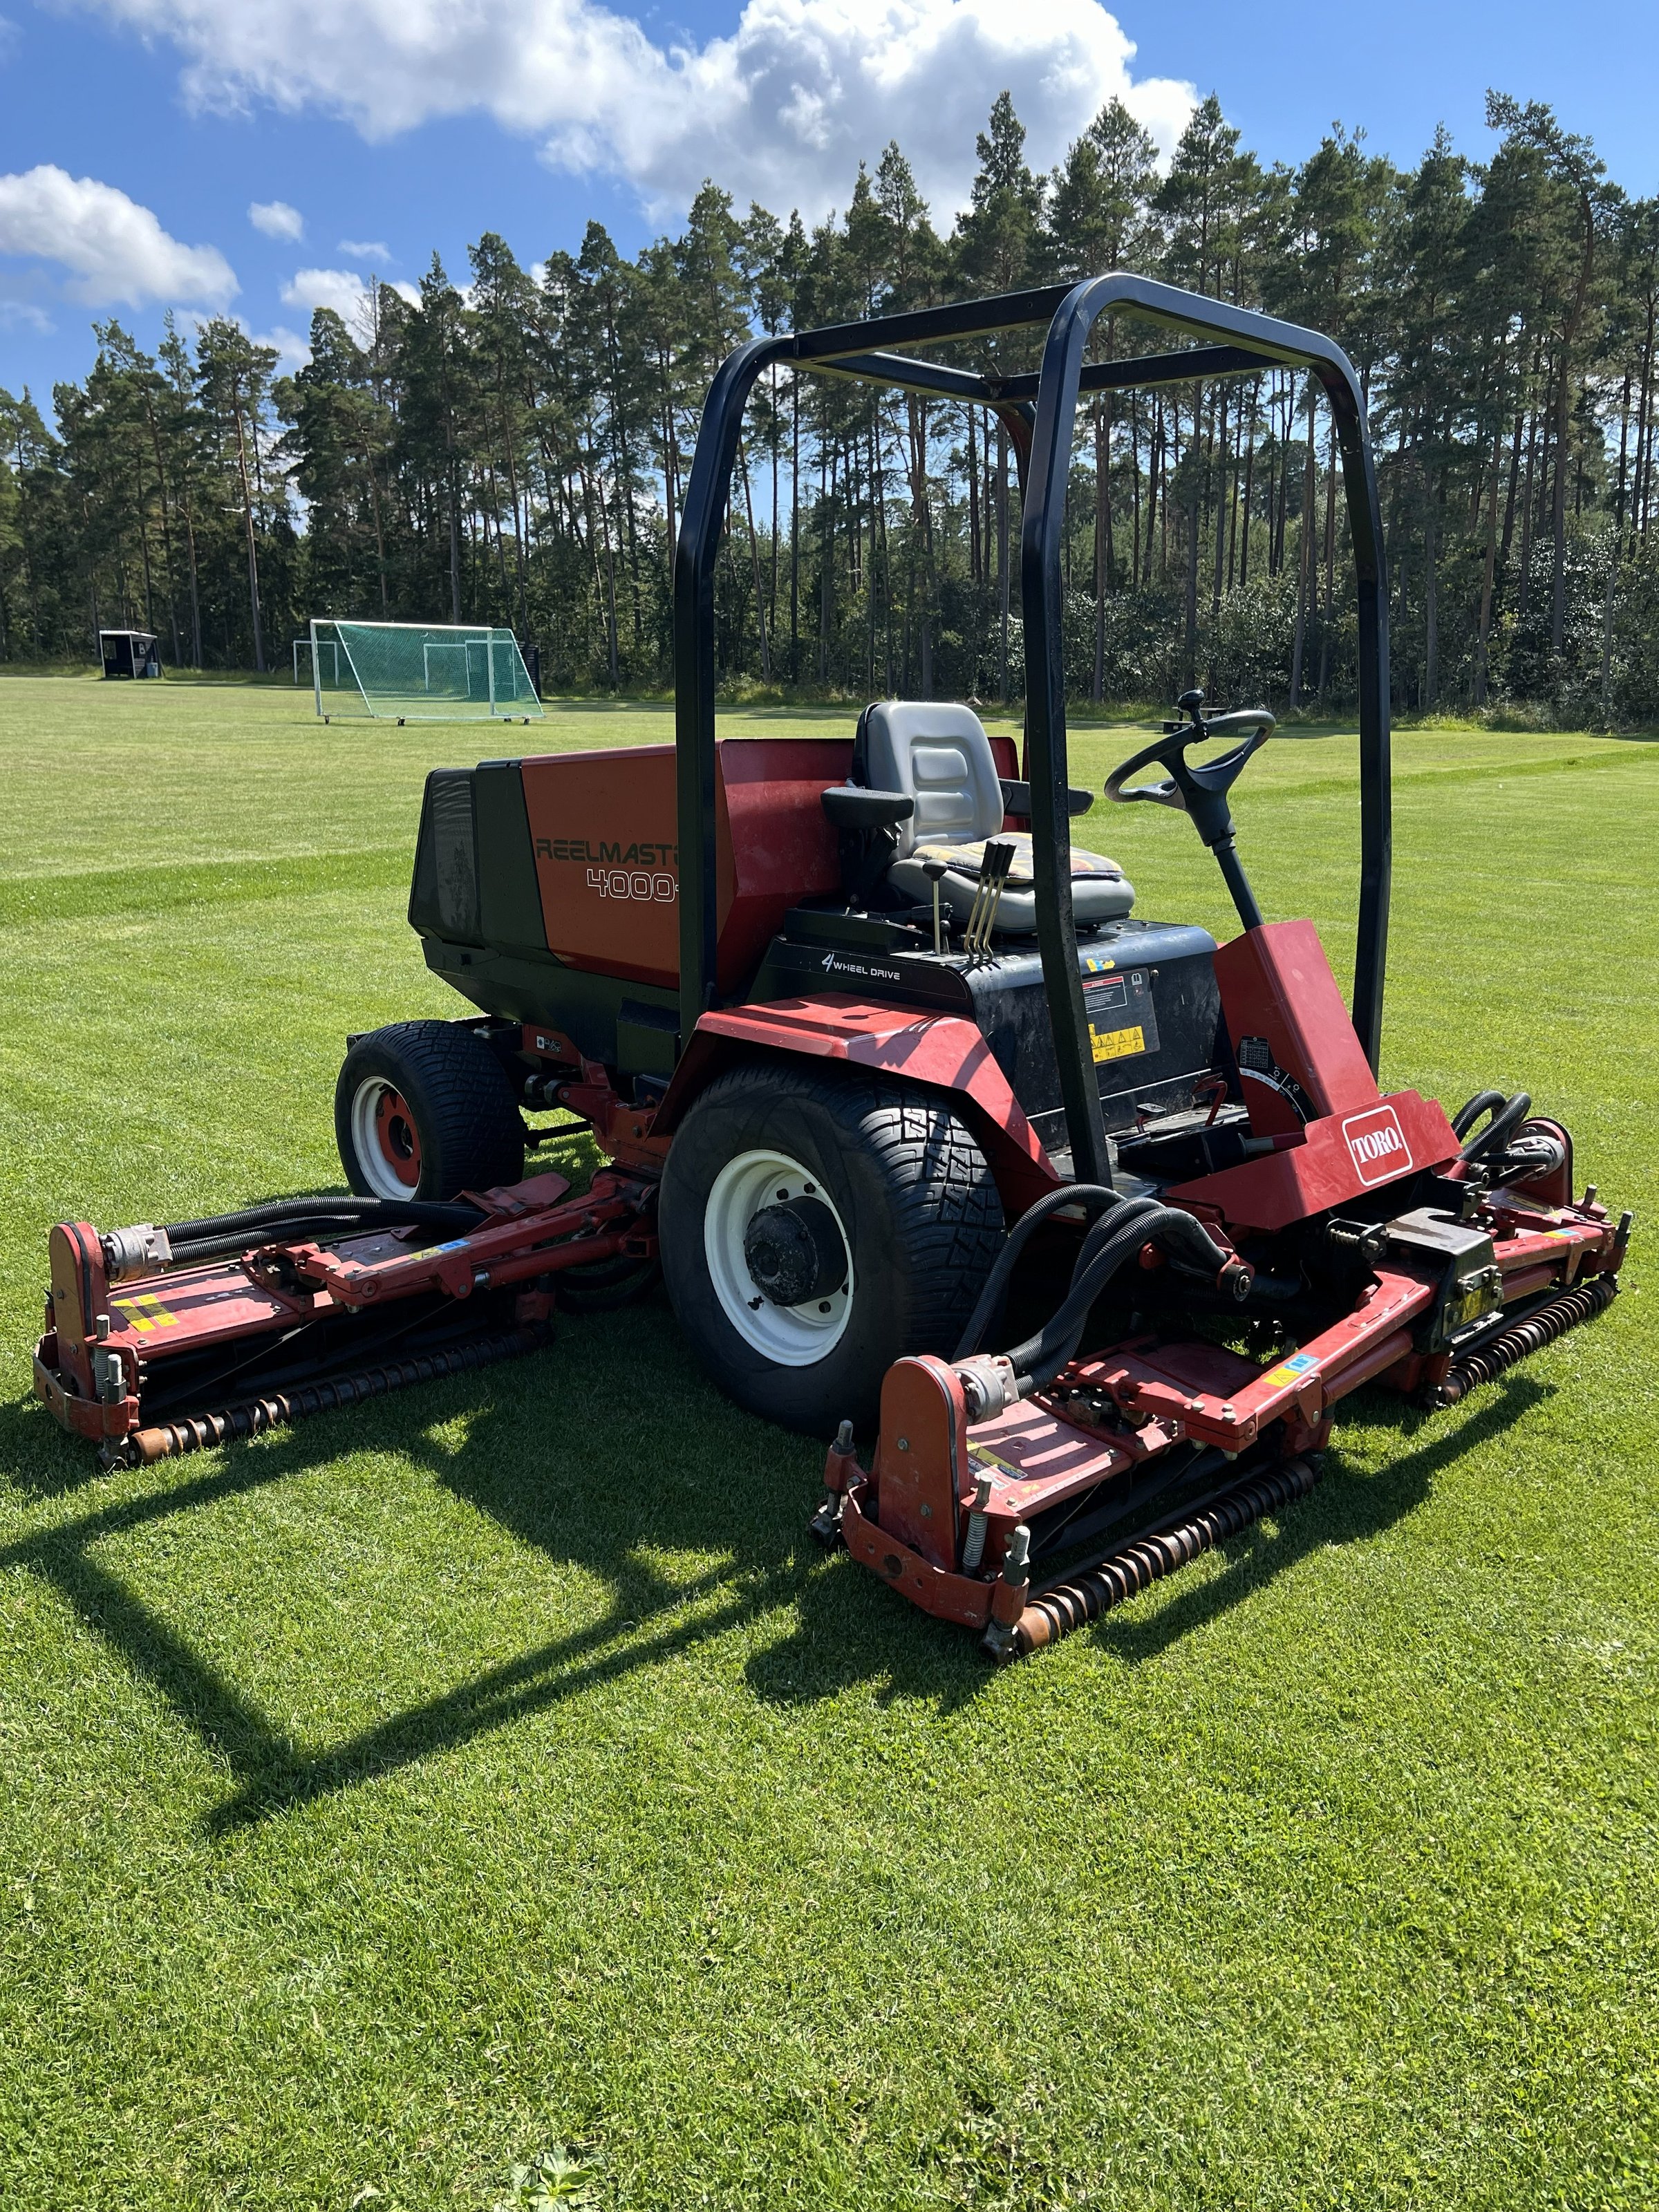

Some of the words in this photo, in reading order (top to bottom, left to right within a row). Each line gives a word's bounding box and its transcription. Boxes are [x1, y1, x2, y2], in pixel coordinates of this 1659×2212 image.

[139, 643, 146, 655] B
[536, 838, 679, 865] REELMAST
[821, 953, 835, 973] 4
[833, 961, 868, 975] WHEEL
[870, 968, 901, 980] DRIVE
[1351, 1126, 1400, 1164] TORO
